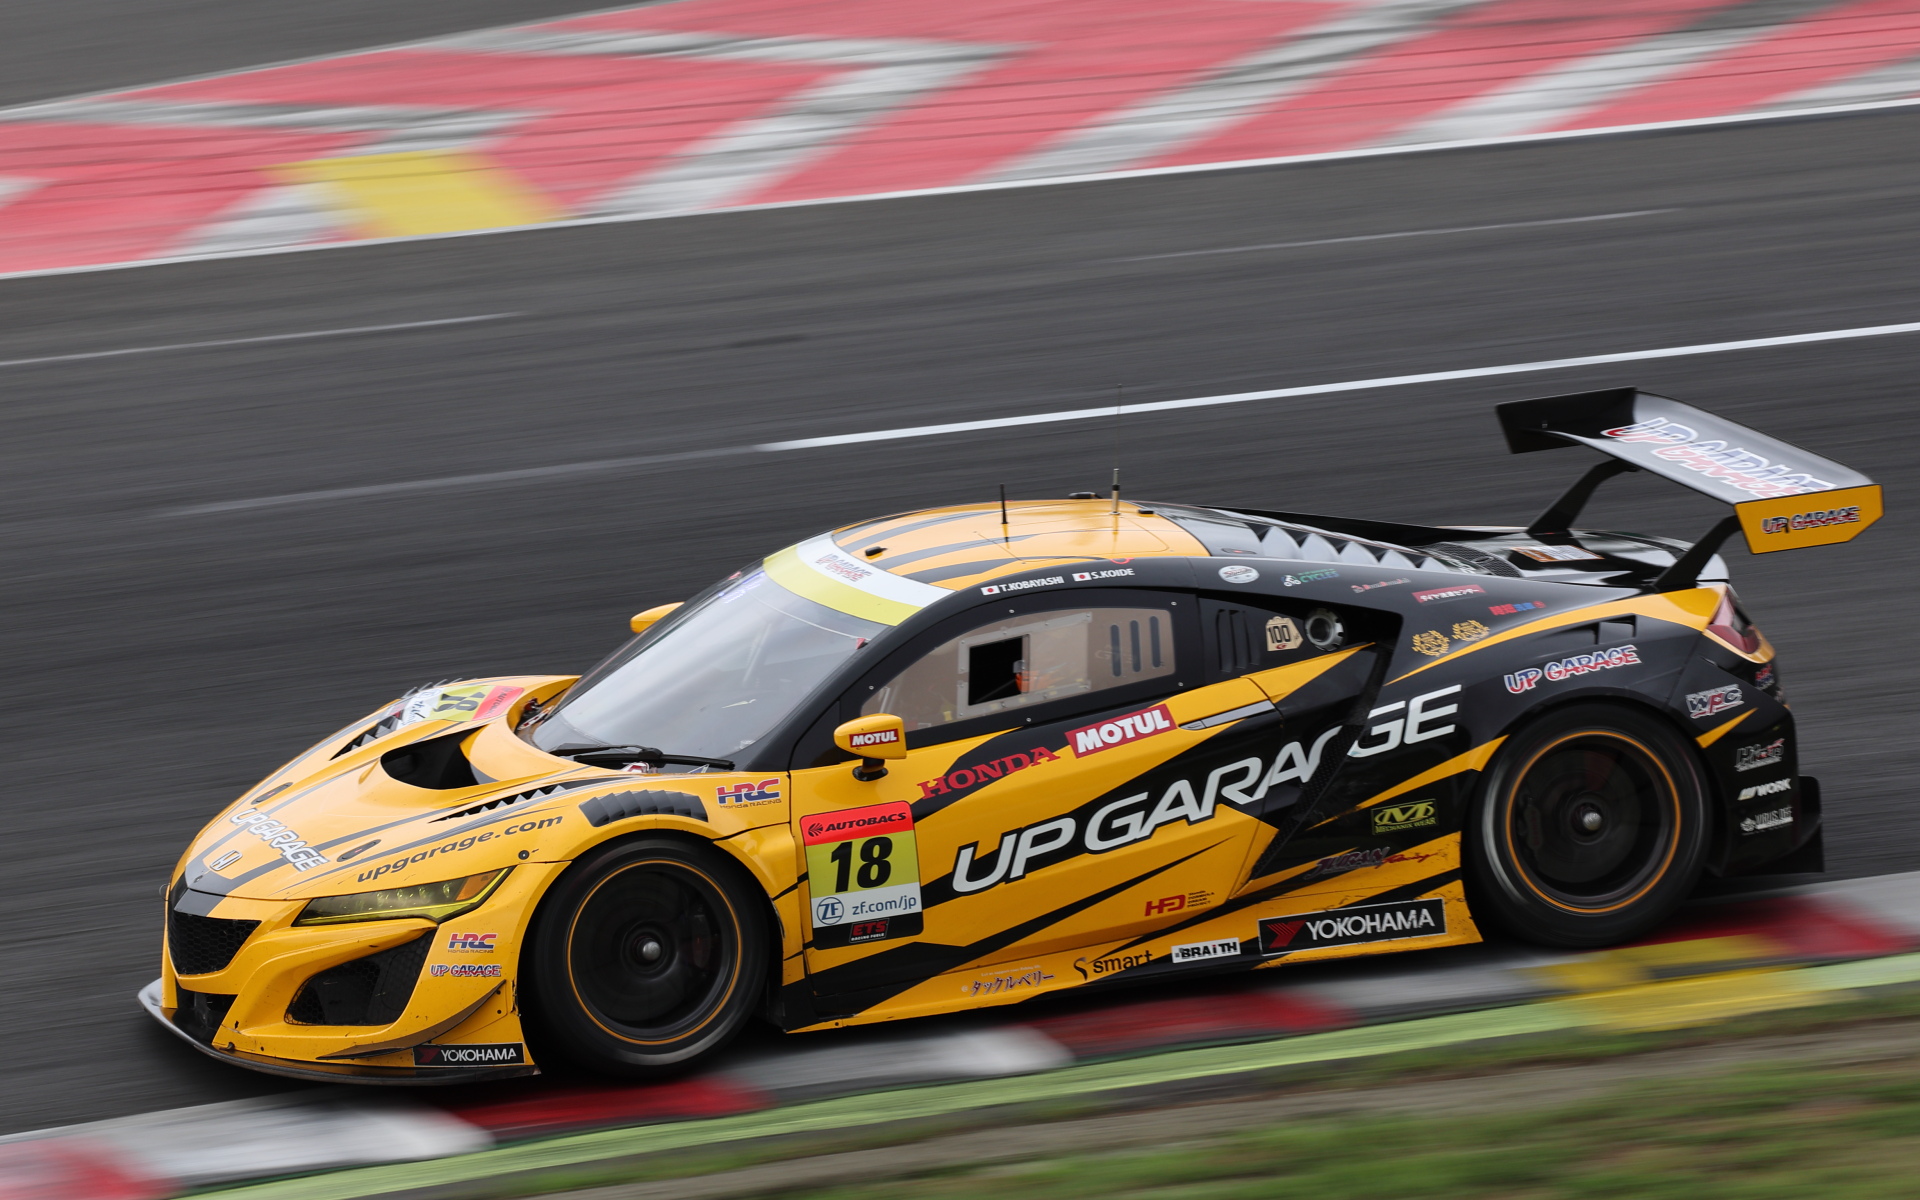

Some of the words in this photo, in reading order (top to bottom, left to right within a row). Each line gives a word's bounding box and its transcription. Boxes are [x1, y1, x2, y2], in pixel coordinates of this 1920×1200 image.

[1600, 416, 1699, 445] UP
[1761, 516, 1789, 534] UP
[1790, 506, 1861, 530] GARAGE
[999, 576, 1065, 592] T.KOBAYASHI
[1091, 568, 1135, 580] S.KOIDE
[1268, 625, 1291, 644] 100
[1503, 667, 1542, 694] UP
[1544, 644, 1642, 681] GARAGE
[1686, 687, 1743, 716] WPC
[852, 730, 897, 746] MOTUL
[1076, 710, 1170, 754] MOTUL
[916, 746, 1061, 800] HONDA
[716, 778, 780, 805] HRC
[952, 818, 1076, 892] UP
[1083, 684, 1462, 851] GARAGE
[1756, 778, 1791, 797] WORK
[230, 807, 270, 826] UP
[825, 812, 907, 832] AUTOBACS
[247, 819, 330, 872] GARAGE
[357, 816, 563, 882] upgarage.com
[831, 836, 893, 893] 18
[852, 895, 917, 916] zf.com/jp
[853, 921, 887, 936] ETS
[1306, 908, 1435, 940] YOKOHAMA
[448, 932, 498, 949] HRC
[430, 964, 449, 977] UP
[450, 964, 502, 978] GARAGE
[1093, 950, 1152, 974] smart
[970, 970, 1055, 997] タックルベリー
[441, 1048, 517, 1061] YOKOHAMA
